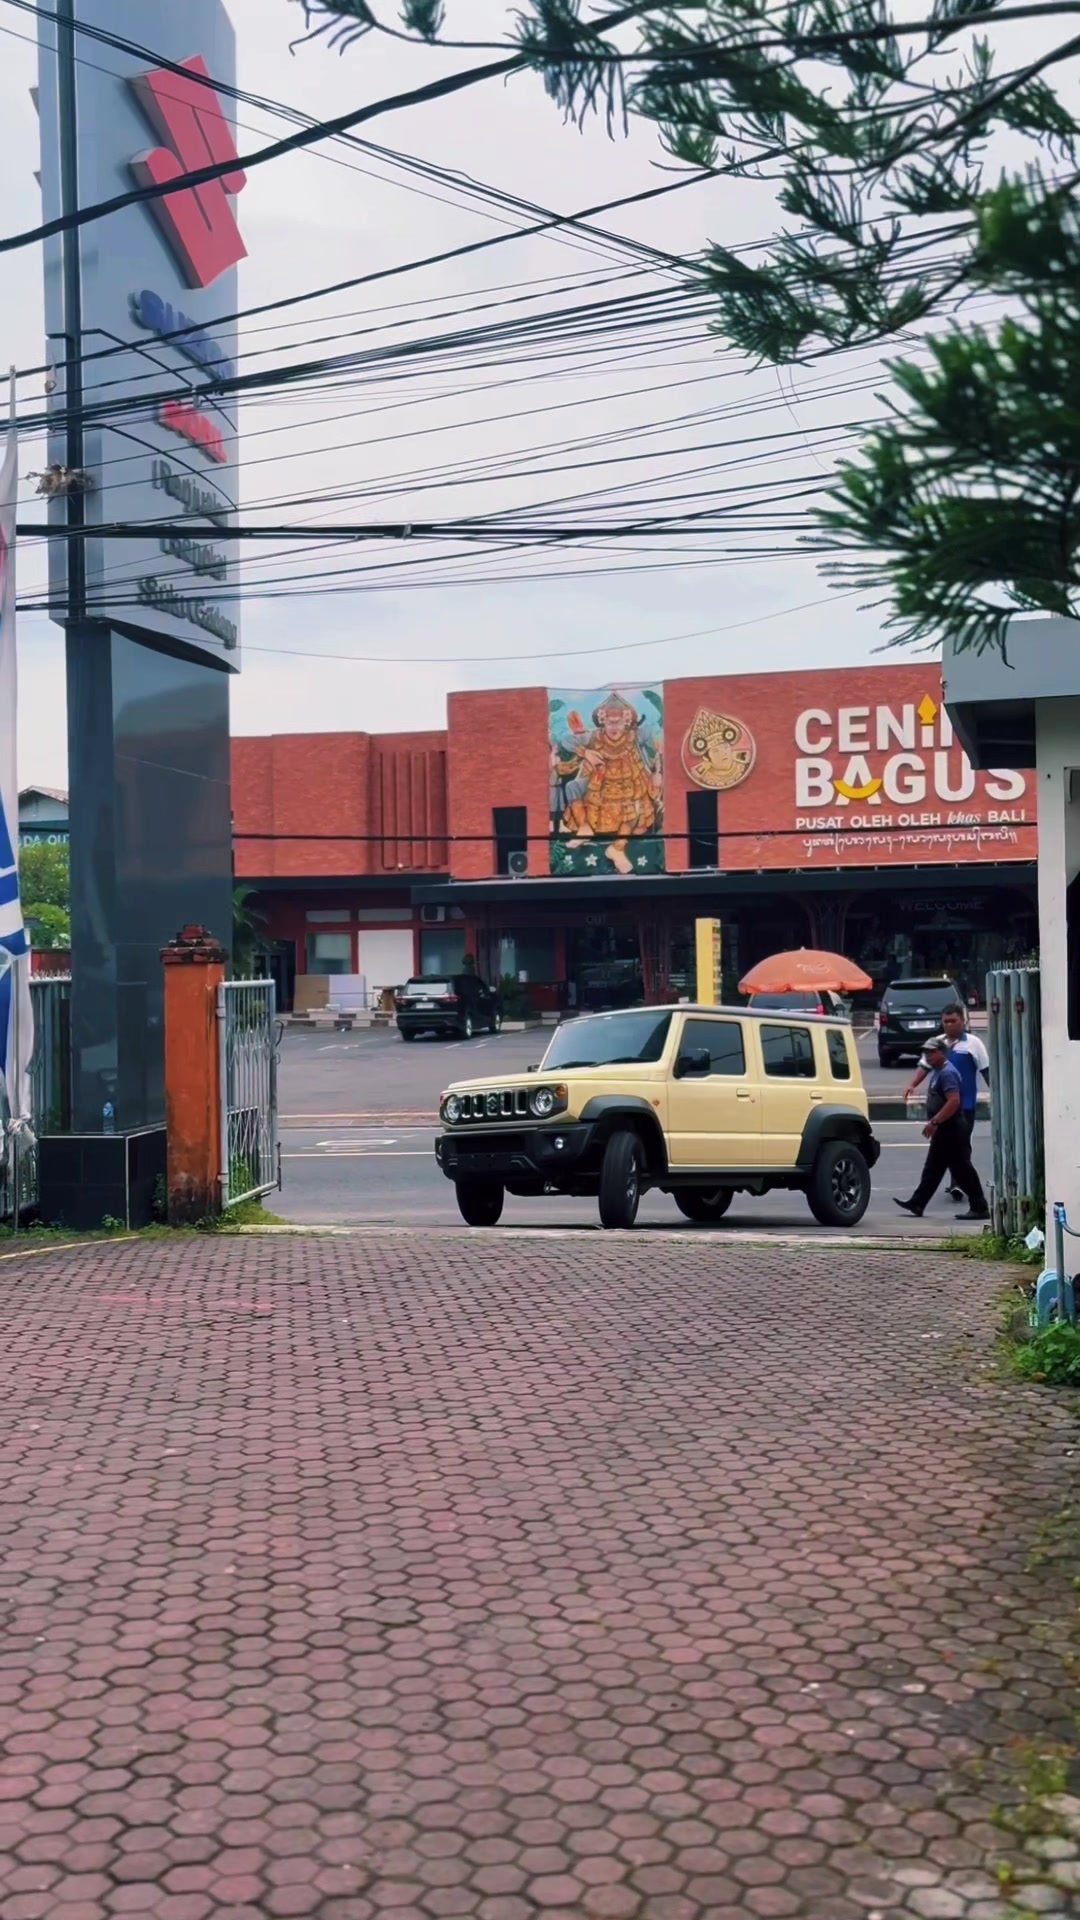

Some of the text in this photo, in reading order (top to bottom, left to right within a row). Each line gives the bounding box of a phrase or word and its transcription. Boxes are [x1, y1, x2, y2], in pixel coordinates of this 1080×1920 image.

[796, 751, 1026, 807] BAGUS
[796, 809, 1026, 830] PUSAT OLEH OLEH khas BALI
